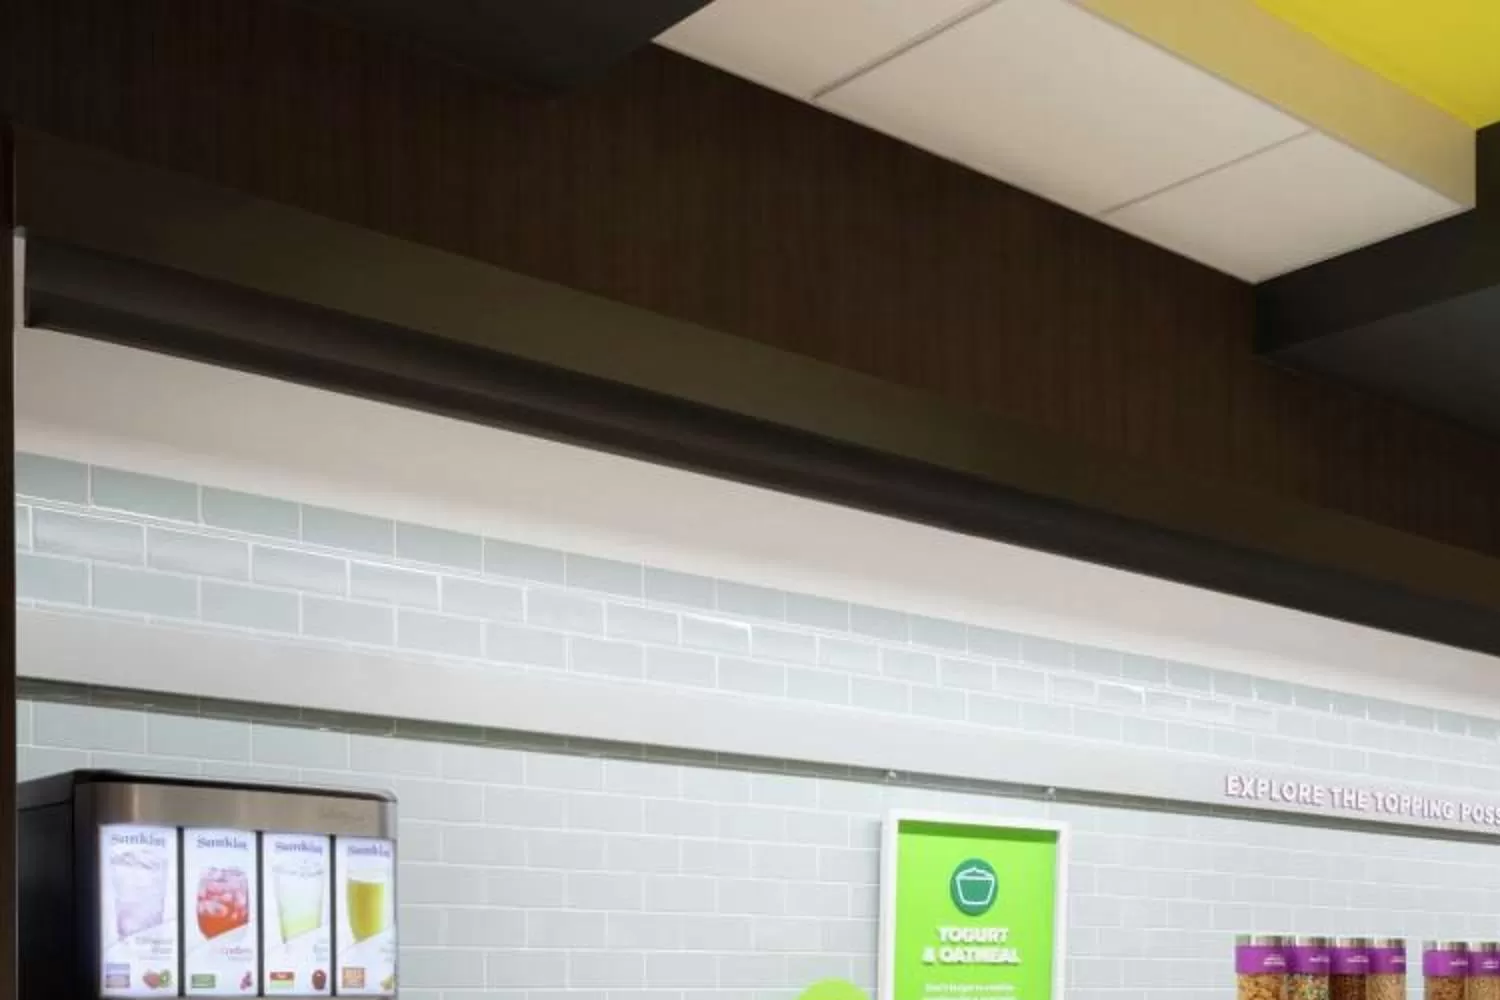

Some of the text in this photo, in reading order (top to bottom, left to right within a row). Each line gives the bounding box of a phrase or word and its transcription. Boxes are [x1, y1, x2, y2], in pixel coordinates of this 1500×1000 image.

[1225, 773, 1325, 807] EXPLORE
[1329, 787, 1366, 813] THE
[1372, 790, 1453, 820] TOPPING
[936, 927, 1009, 944] YOGURT
[938, 946, 1021, 965] OATMEAL
